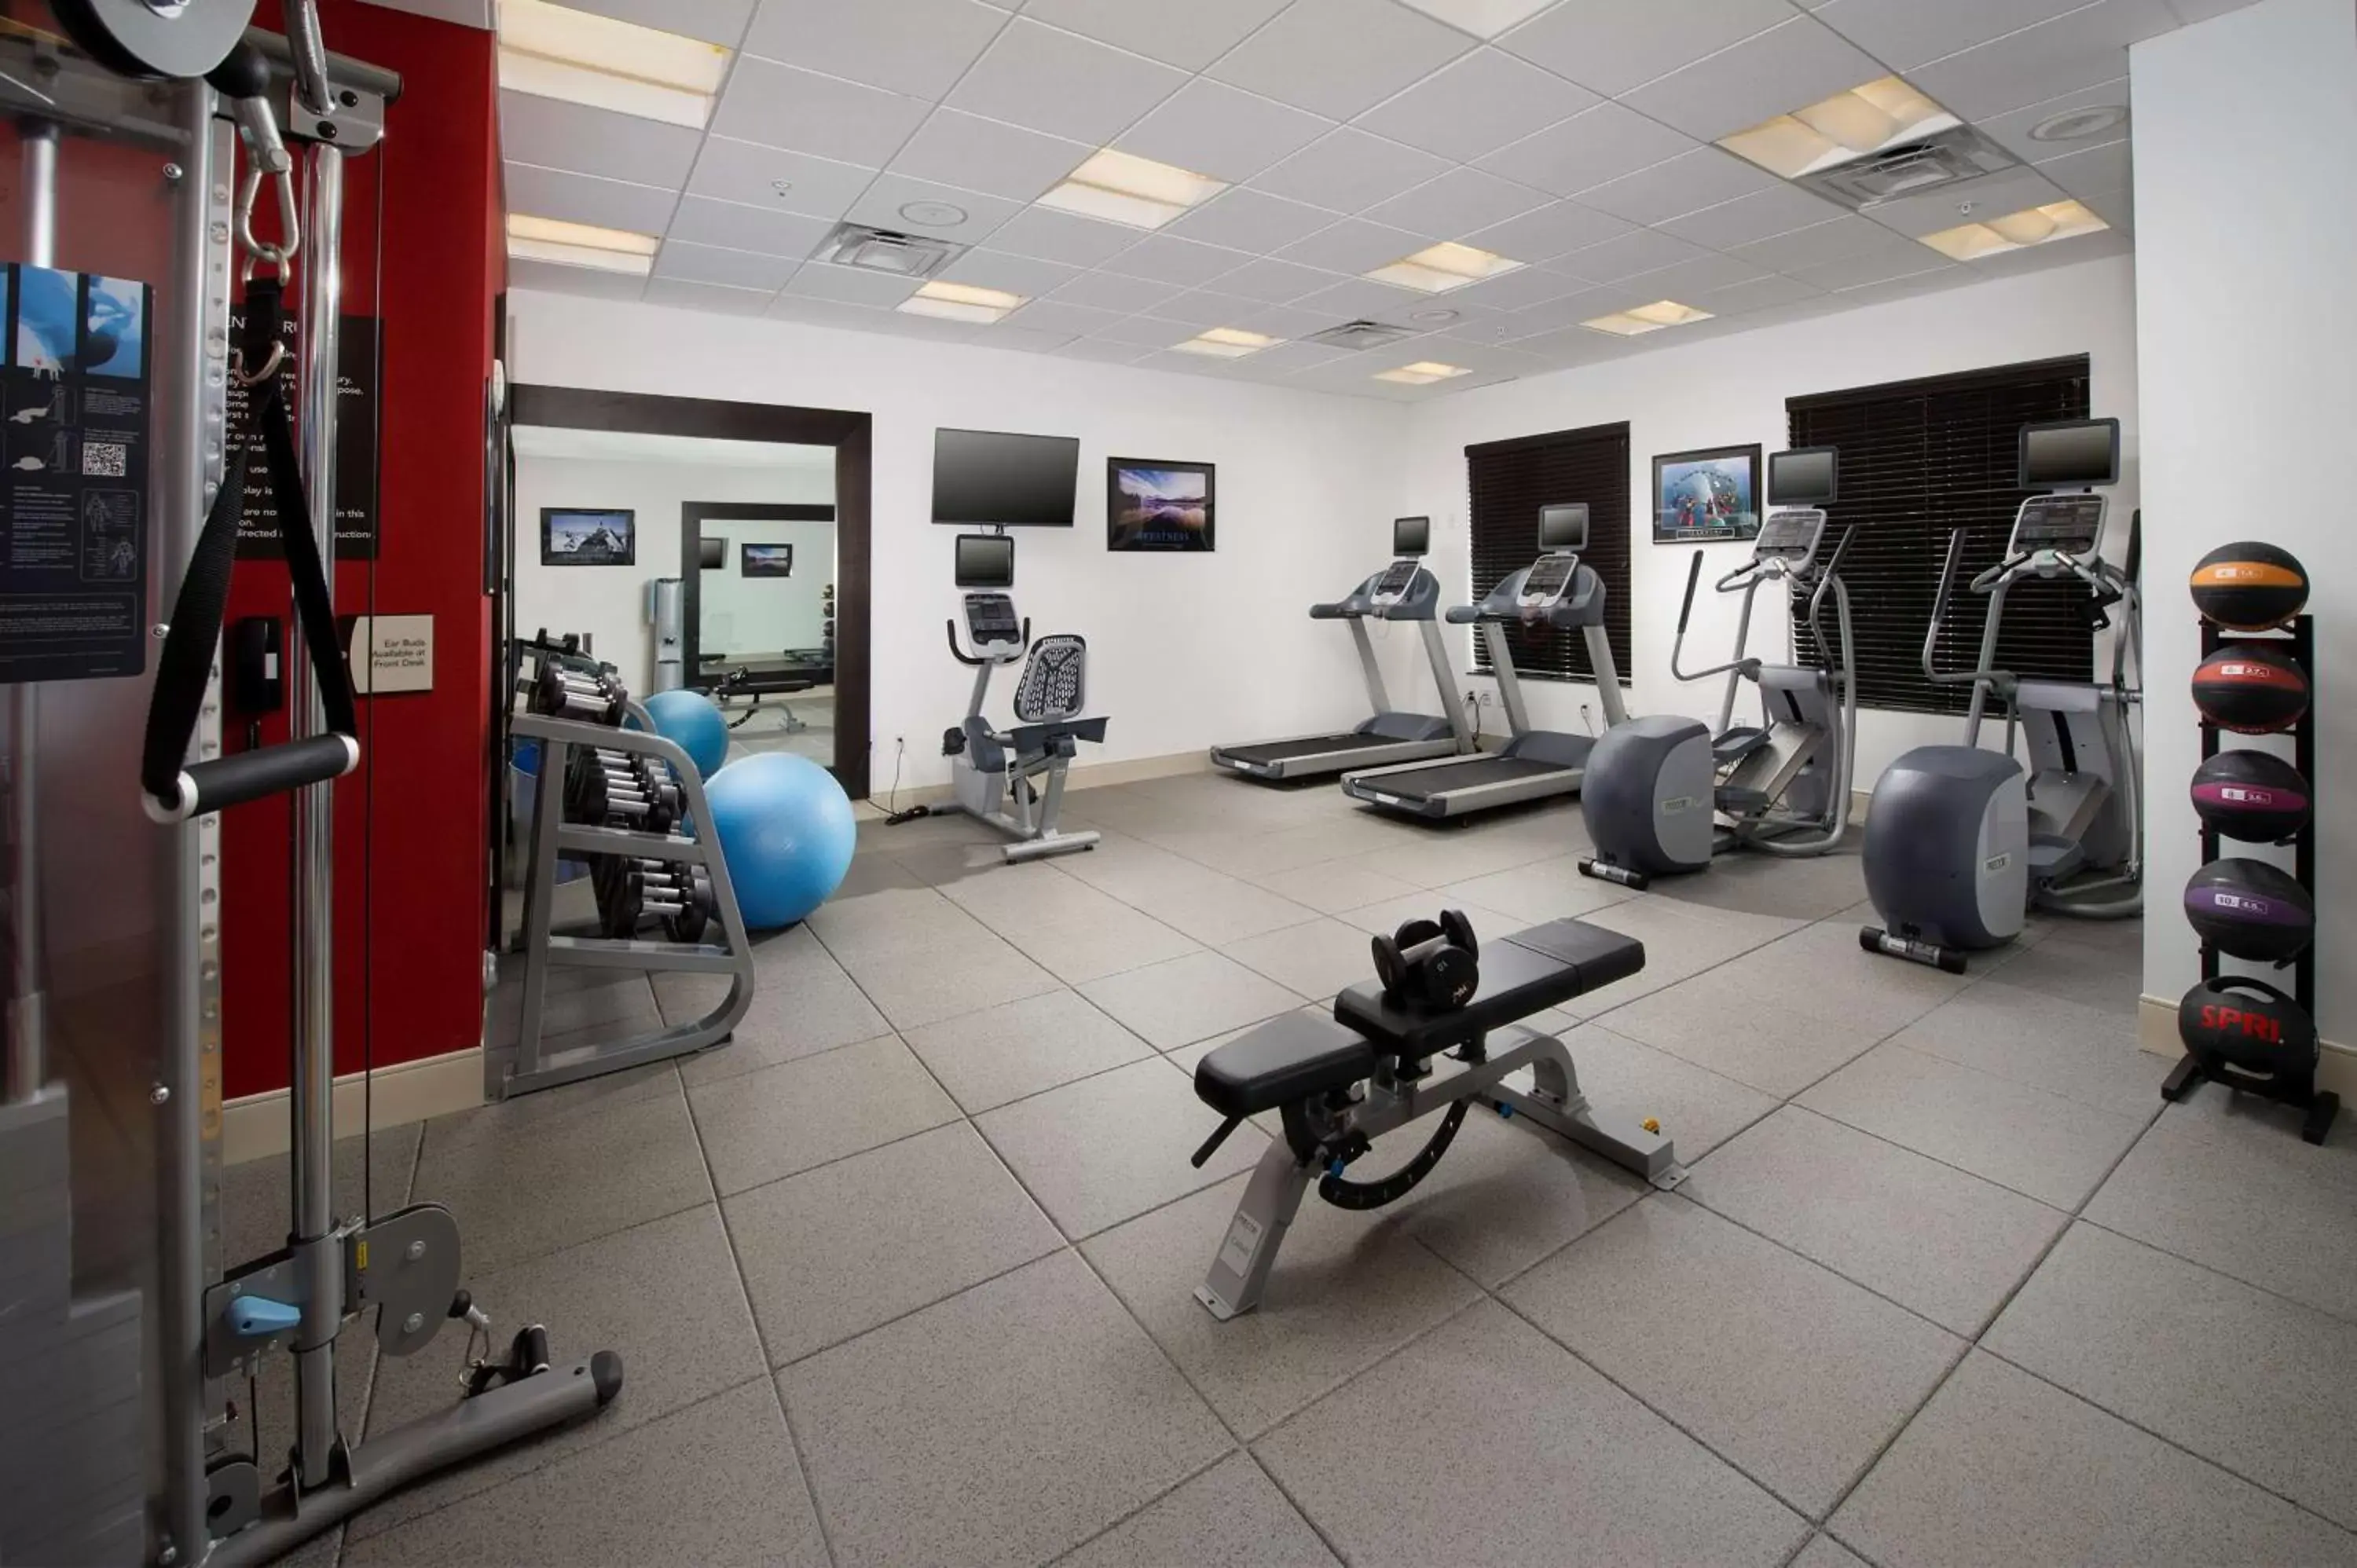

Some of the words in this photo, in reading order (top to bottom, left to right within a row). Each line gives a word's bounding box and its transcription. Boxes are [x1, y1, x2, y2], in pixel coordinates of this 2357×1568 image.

[347, 509, 365, 518] this
[383, 639, 399, 648] Ear
[2201, 1005, 2281, 1044] SPRI
